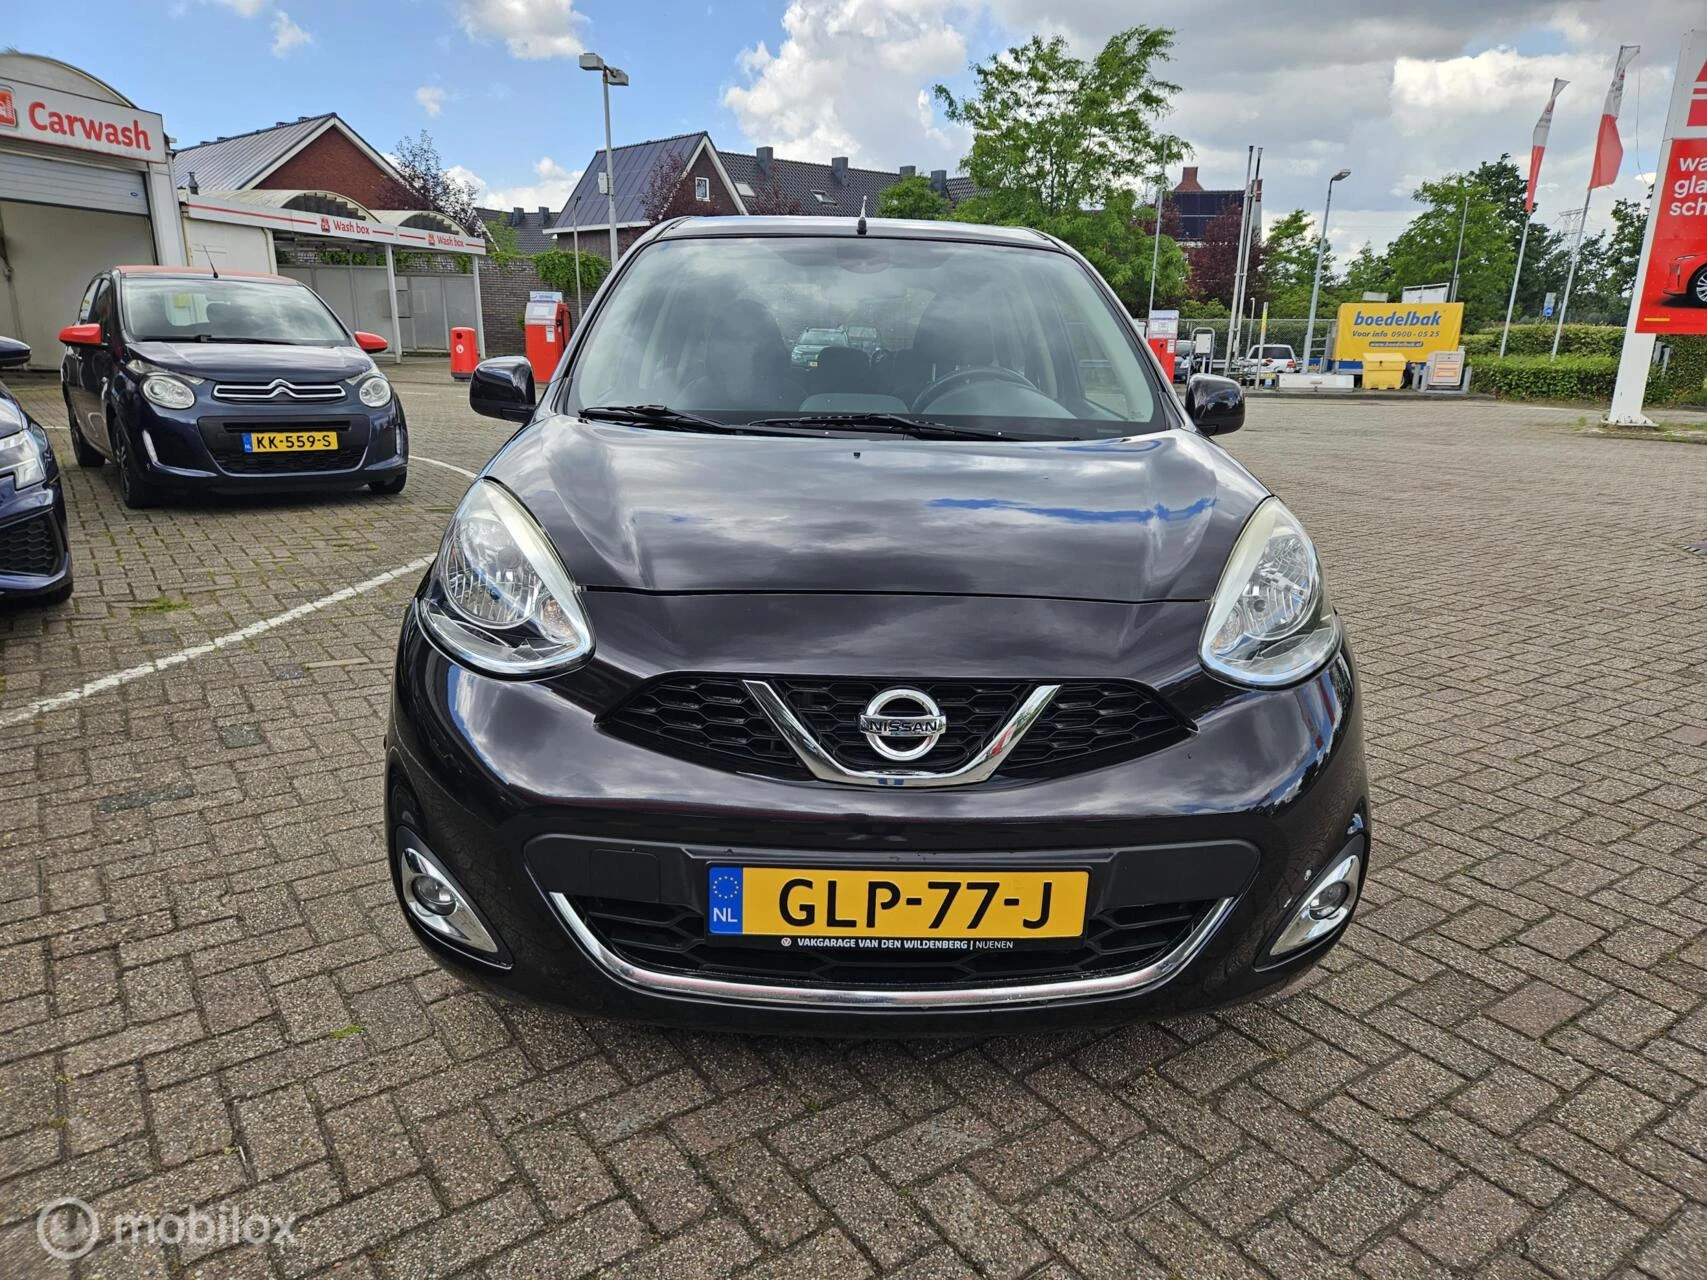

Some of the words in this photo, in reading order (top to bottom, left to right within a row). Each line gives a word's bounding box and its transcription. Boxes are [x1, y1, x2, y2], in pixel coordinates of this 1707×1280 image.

[28, 101, 151, 150] Carwash
[333, 219, 354, 233] Wash
[355, 223, 370, 235] box
[436, 235, 453, 246] Wash
[454, 237, 464, 247] box
[1353, 310, 1441, 326] boedelbak
[256, 434, 331, 449] KK-559-S
[868, 720, 937, 732] NISSAN
[779, 878, 1053, 929] GLP-77-J
[713, 907, 738, 922] NL
[797, 938, 856, 948] VAKGARAGE
[858, 939, 879, 948] VAN
[881, 939, 901, 949] DEN
[904, 940, 968, 949] WILDENBERG
[975, 941, 1014, 949] NUENEN
